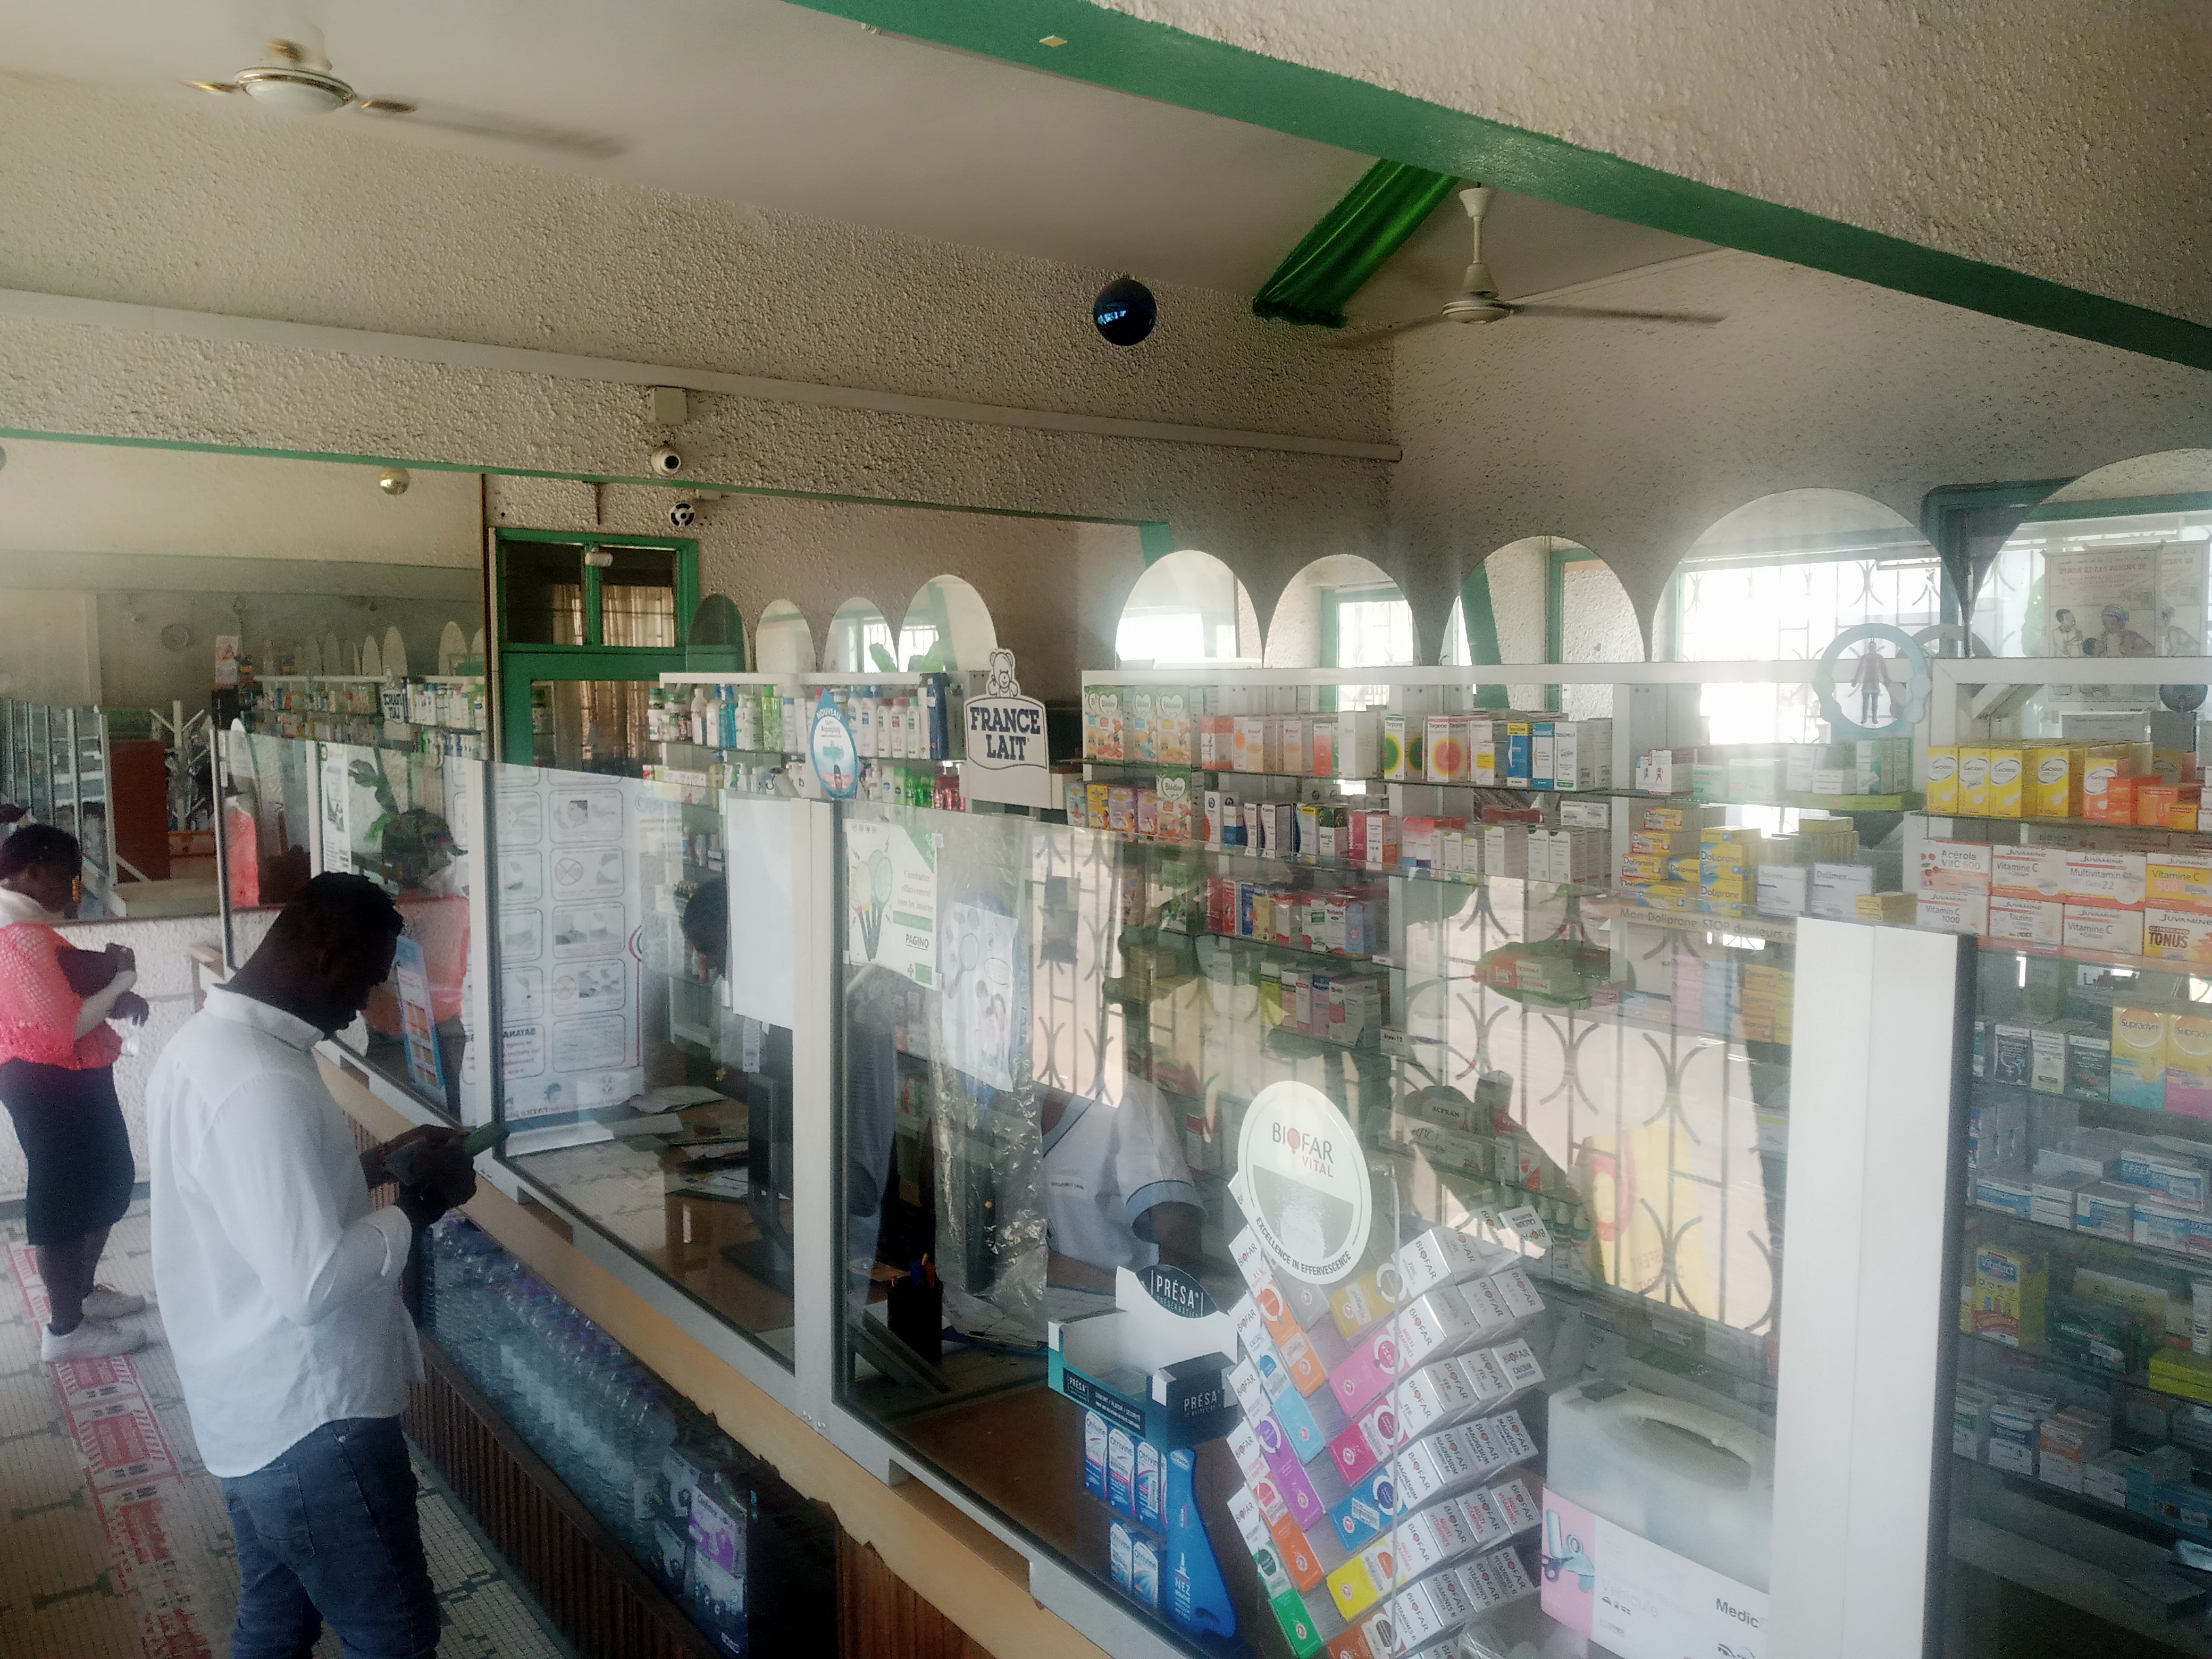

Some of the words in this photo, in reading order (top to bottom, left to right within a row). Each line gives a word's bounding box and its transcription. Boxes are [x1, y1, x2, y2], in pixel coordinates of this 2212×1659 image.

[816, 708, 841, 720] NOUVEAU
[970, 707, 1040, 734] FRANCE
[986, 734, 1027, 760] LAIT
[1670, 864, 1698, 874] Doliprane
[1702, 851, 1740, 864] Doliprane
[1963, 861, 1980, 870] 500
[1997, 862, 2030, 872] Vitamine
[2032, 863, 2039, 873] C
[1816, 871, 1847, 880] Dolimex
[2102, 881, 2115, 890] 22
[2152, 870, 2191, 881] Vitamine
[2193, 873, 2200, 882] C
[2156, 881, 2179, 891] 500
[1702, 886, 1739, 898] Doliprane
[1925, 906, 1954, 915] Vitamin
[1942, 915, 1960, 924] 1000
[2160, 915, 2212, 925] JUVAMINE
[1621, 908, 1644, 919] Mon
[1648, 912, 1697, 928] Doliprane
[1703, 919, 1730, 929] STOP
[1733, 924, 1783, 939] douleurs
[2068, 923, 2104, 934] Vitamine
[2106, 925, 2114, 935] C
[906, 934, 929, 949] PAGINO
[2149, 932, 2188, 949] TONUS
[2122, 1019, 2158, 1032] Supradyn
[1272, 1122, 1334, 1164] BIOFAR
[1302, 1155, 1334, 1178] VITAL
[1238, 1243, 1257, 1267] BIOFAR
[1256, 1217, 1292, 1264] EXCELLENCE
[1292, 1259, 1299, 1270] IN
[1301, 1251, 1351, 1276] EFFERVESCENCE
[1415, 1241, 1436, 1279] BIOFAR
[1157, 1275, 1195, 1309] PRÉSA
[1479, 1282, 1503, 1317] BIOFAR
[1512, 1272, 1535, 1306] BIOFAR
[1237, 1309, 1256, 1333] BIOFAR
[1409, 1308, 1432, 1346] BIOFAR
[1503, 1348, 1530, 1364] BIOFAR
[1445, 1363, 1468, 1399] BIOFAR
[1478, 1369, 1487, 1380] FER
[1480, 1353, 1503, 1389] BIOFAR
[1237, 1375, 1255, 1397] BIOFAR
[1442, 1378, 1452, 1390] FER
[1184, 1394, 1217, 1412] PRÉSA
[1409, 1380, 1431, 1419] BIOFAR
[1086, 1419, 1107, 1436] Otrivine
[1506, 1416, 1530, 1452] BIOFAR
[1110, 1437, 1133, 1456] Otrivine
[1235, 1437, 1253, 1459] BIOFAR
[1445, 1434, 1468, 1471] BIOFAR
[1467, 1427, 1489, 1465] MAGNÉSIUM
[1476, 1423, 1499, 1461] BIOFAR
[1138, 1450, 1166, 1469] Otrivine
[1437, 1437, 1458, 1476] MAGNÉSIUM
[1408, 1452, 1430, 1490] BIOFAR
[1235, 1502, 1254, 1523] BIOFAR
[1477, 1493, 1500, 1531] BIOFAR
[1511, 1485, 1534, 1522] BIOFAR
[1444, 1505, 1467, 1543] BIOFAR
[1408, 1523, 1430, 1562] BIOFAR
[1134, 1549, 1157, 1570] Otrivine
[1502, 1552, 1526, 1589] BIOFAR
[1175, 1579, 1190, 1596] NEZ
[1442, 1574, 1465, 1613] BIOFAR
[1468, 1566, 1488, 1600] VITAMINES
[1477, 1562, 1499, 1602] BIOFAR
[1432, 1577, 1453, 1613] VITAMINES
[1406, 1593, 1429, 1632] BIOFAR
[1716, 1598, 1758, 1628] Medic
